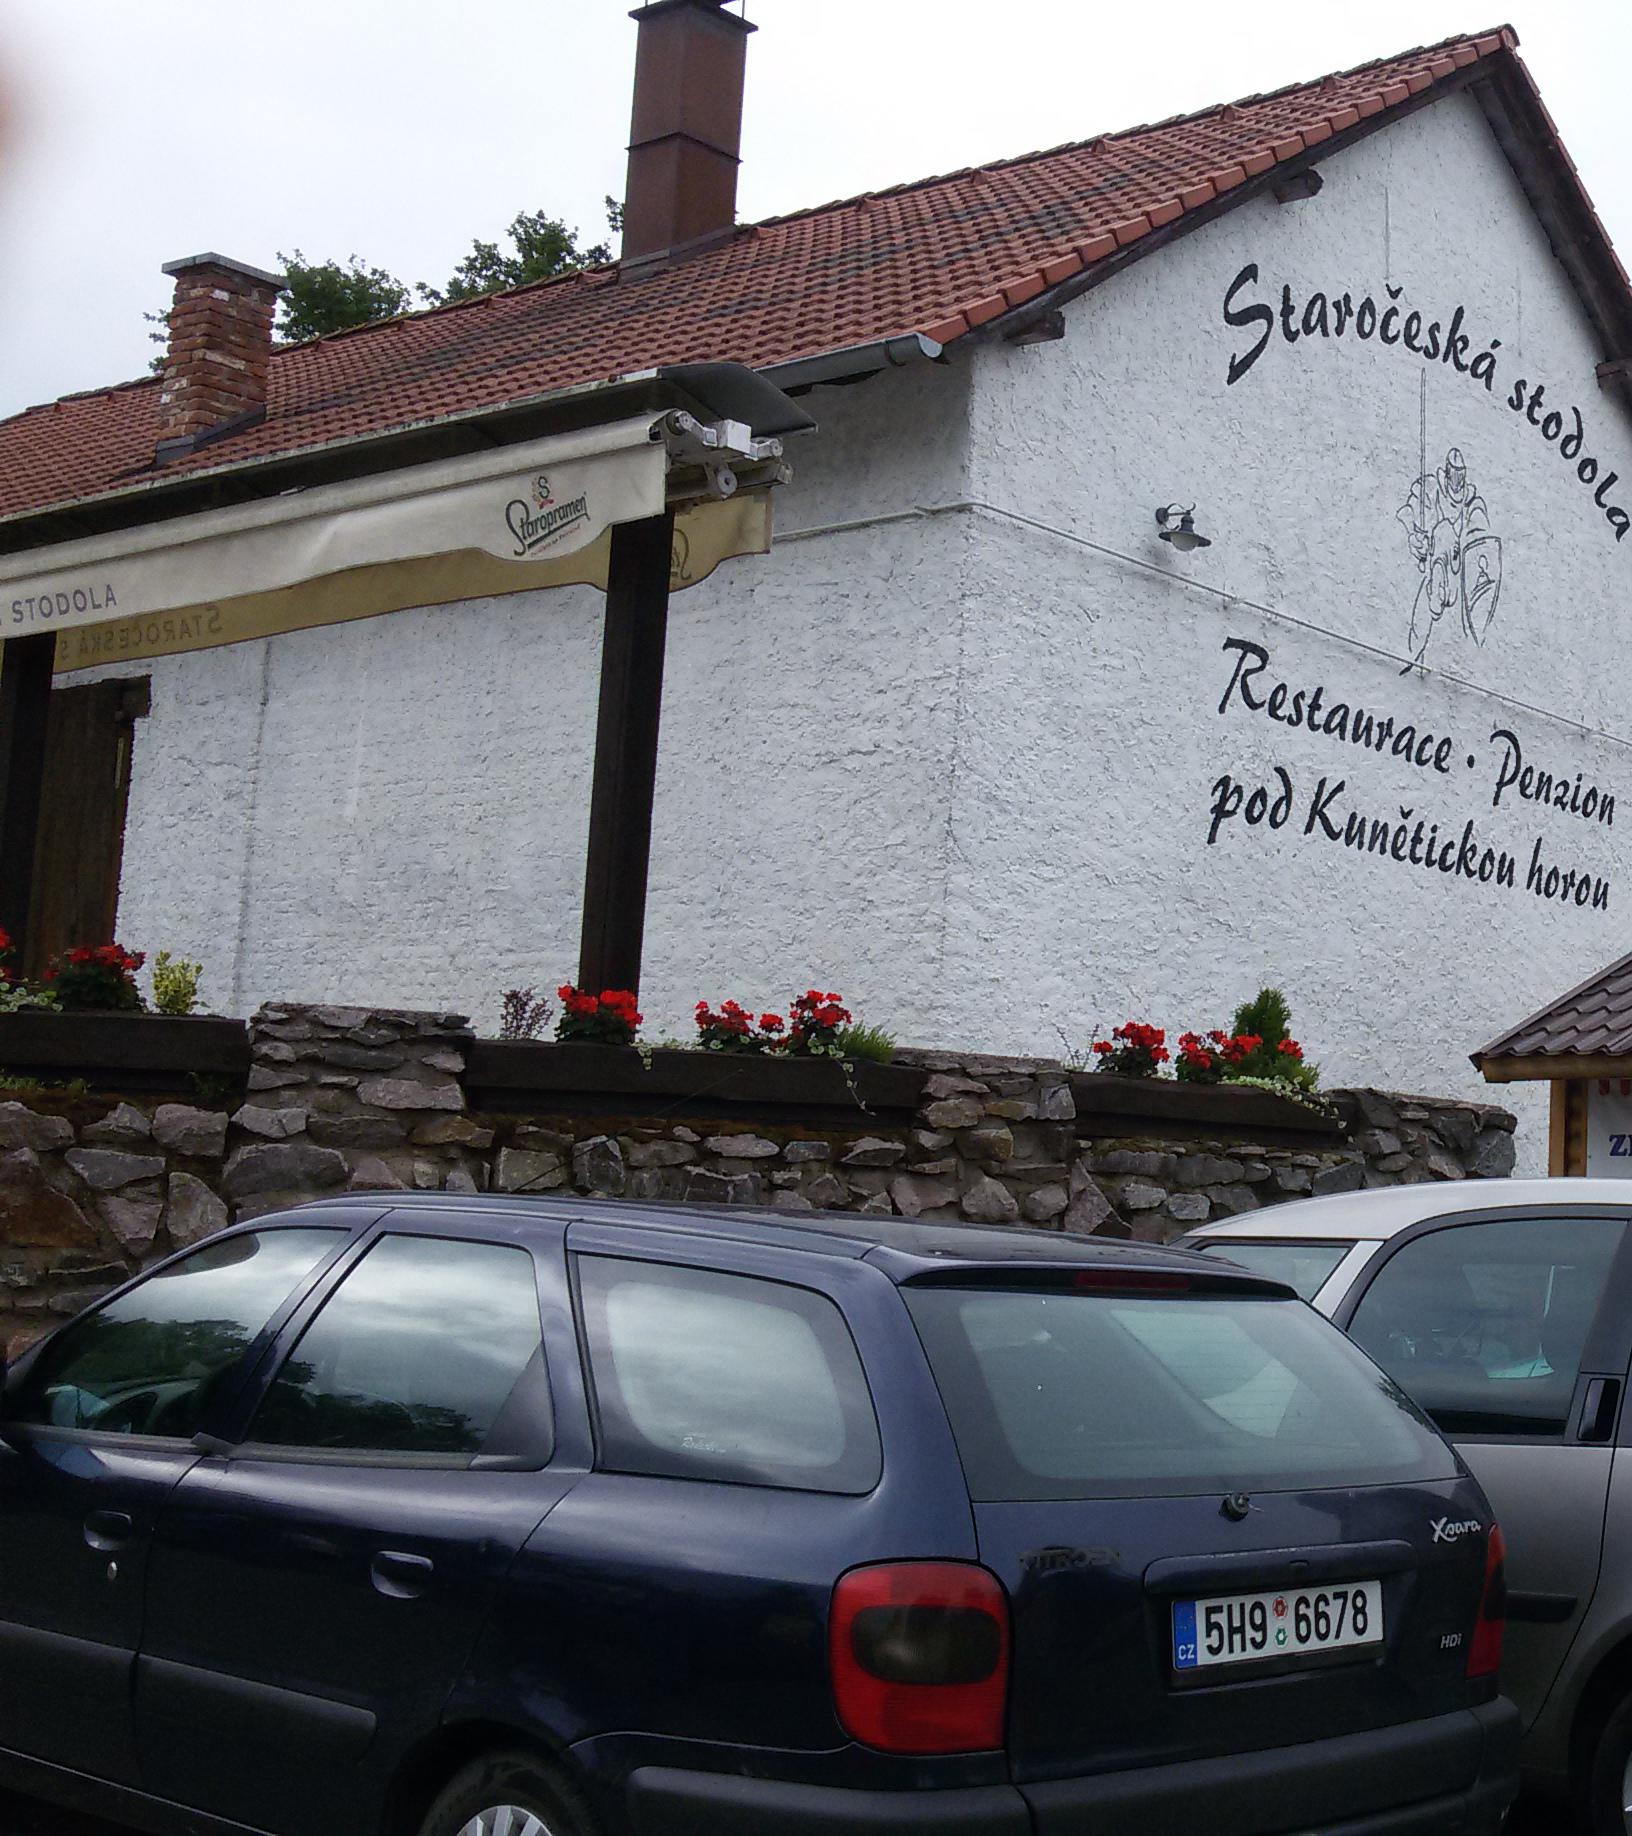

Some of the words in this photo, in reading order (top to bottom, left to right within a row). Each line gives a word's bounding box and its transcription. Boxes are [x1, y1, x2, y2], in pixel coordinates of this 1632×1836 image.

[1223, 263, 1502, 391] Staročeská
[1508, 378, 1631, 543] stodola
[505, 495, 588, 556] Staropramen
[11, 583, 117, 624] STODOLA
[1219, 636, 1452, 773] Restaurace
[1490, 729, 1616, 826] Penzion
[1207, 767, 1293, 845] pod
[1304, 777, 1516, 889] Kunětickou
[1527, 837, 1610, 911] horou
[1430, 1516, 1482, 1543] Xsara
[1178, 1644, 1195, 1660] CZ
[1205, 1600, 1268, 1656] 5H9
[1294, 1589, 1368, 1645] 6678
[1440, 1633, 1462, 1649] HDi
